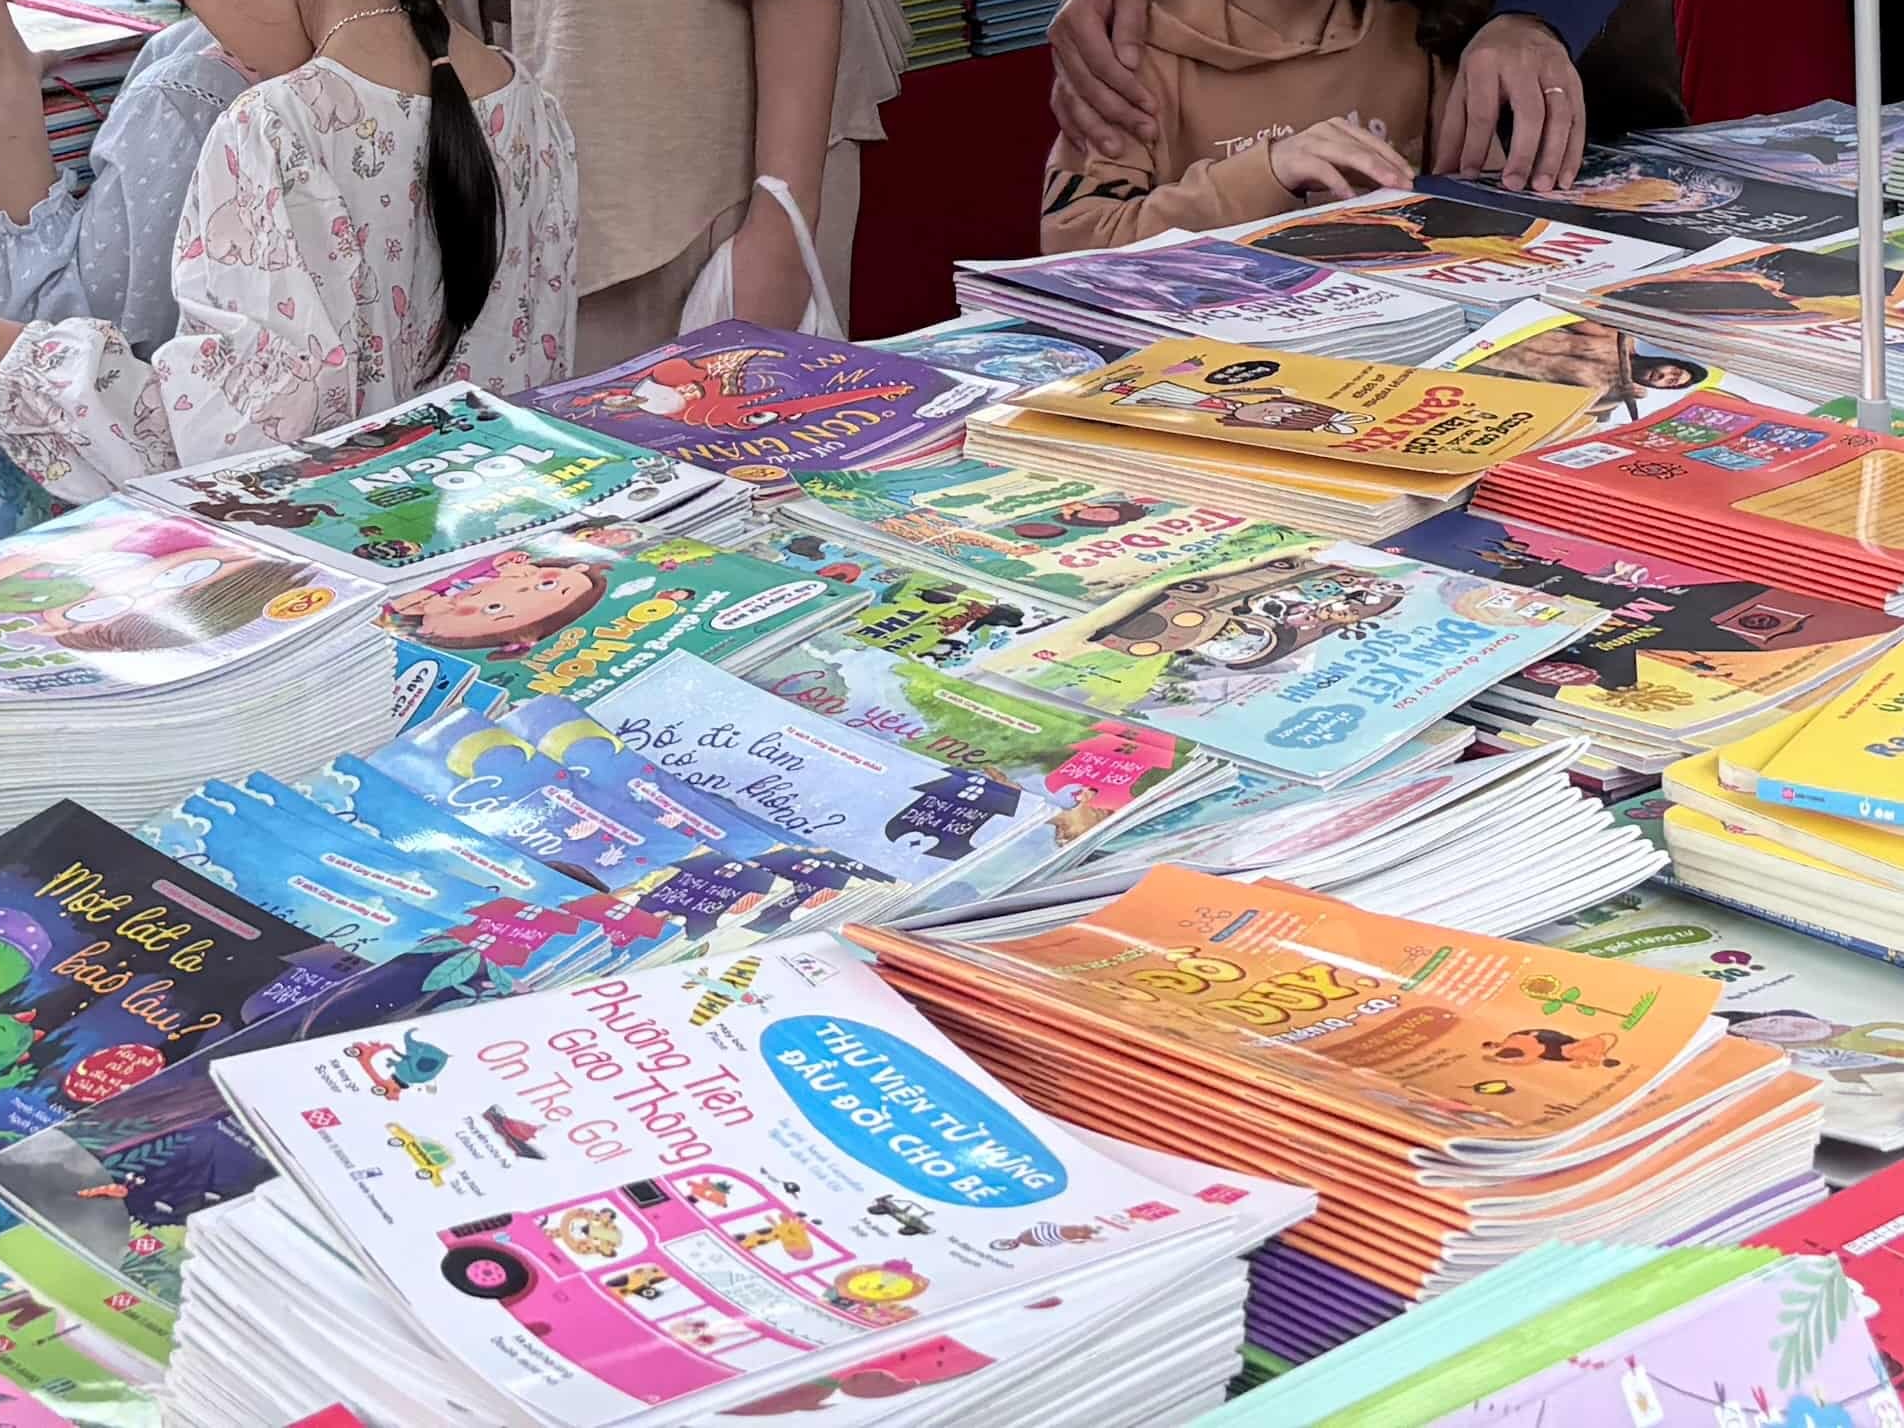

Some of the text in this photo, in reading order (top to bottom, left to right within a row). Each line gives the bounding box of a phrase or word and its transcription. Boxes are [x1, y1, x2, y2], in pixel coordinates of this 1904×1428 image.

[431, 443, 555, 492] 100
[1141, 506, 1247, 542] Trái
[1343, 628, 1411, 667] SỨC
[1348, 617, 1496, 704] ĐOÀN KẾT
[615, 716, 806, 773] Bố đi làm
[662, 749, 698, 768] có
[768, 670, 994, 768] Con yêu mẹ
[737, 773, 847, 837] không?
[34, 861, 133, 924] Một
[115, 905, 193, 952] lát
[168, 938, 216, 973] là
[120, 979, 224, 1042] lâu?
[572, 979, 757, 1128] Phương Tiện
[476, 1039, 633, 1165] On The Go!
[547, 1027, 625, 1083] Giao
[613, 1075, 713, 1166] Thông
[776, 1047, 849, 1092] ĐẦU
[831, 1094, 894, 1136] ĐỜI
[888, 1132, 957, 1178] CHO
[951, 1172, 1008, 1203] BÉ
[816, 1022, 880, 1068] THƯ
[870, 1068, 932, 1115] VIỆN
[930, 1113, 984, 1144] TỪ
